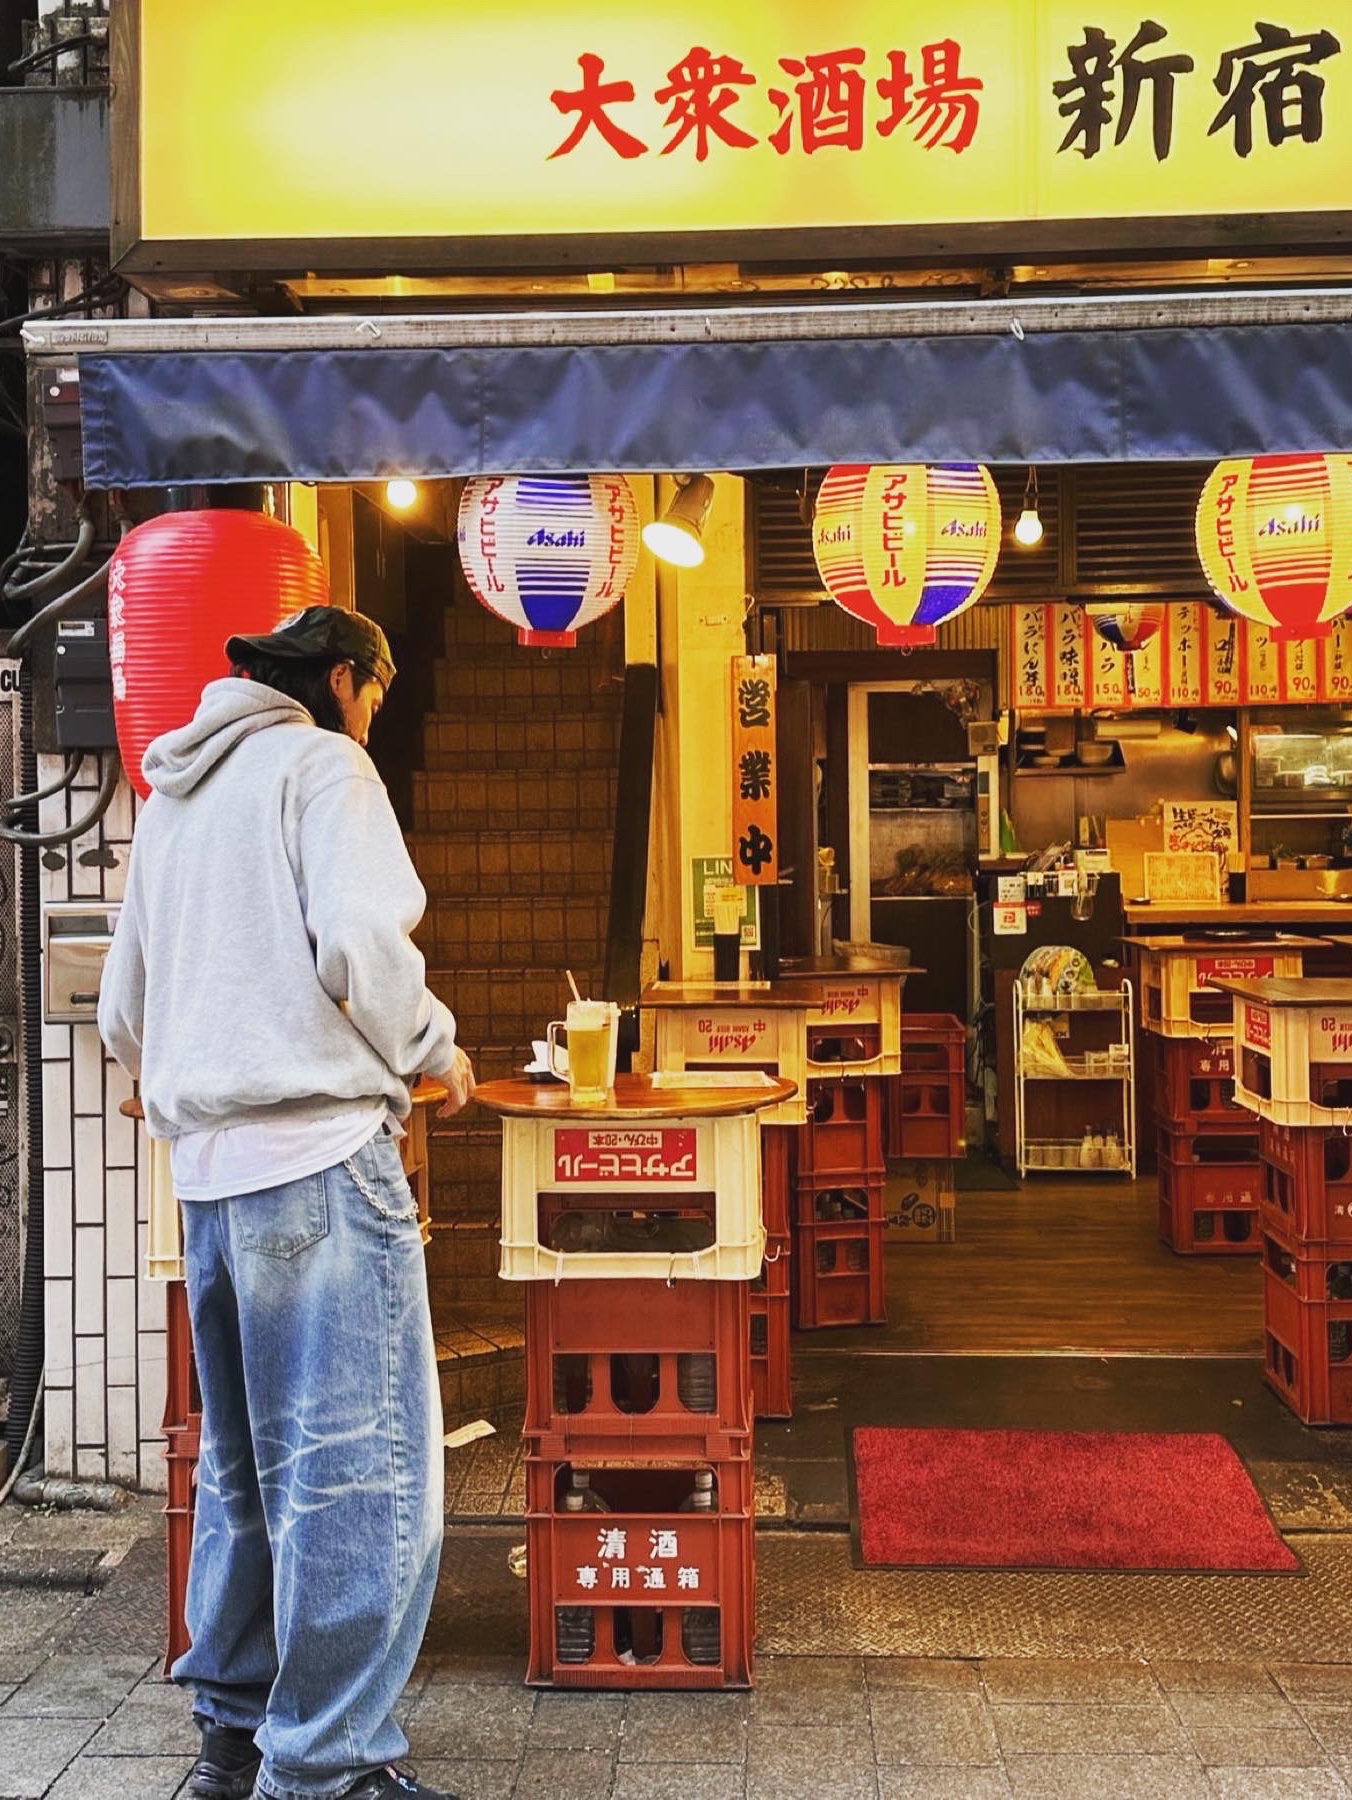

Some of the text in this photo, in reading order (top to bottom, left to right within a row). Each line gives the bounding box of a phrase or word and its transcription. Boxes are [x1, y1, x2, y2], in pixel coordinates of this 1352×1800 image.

[545, 20, 1341, 163] 大衆酒場 新宿
[818, 525, 851, 546] sahi
[882, 474, 908, 587] アサヒビール
[941, 520, 988, 539] Asahi
[1217, 475, 1249, 592] アサヒビール
[1258, 513, 1321, 536] Asahi
[526, 528, 586, 548] Asahi
[595, 484, 625, 598] アサヒビール
[738, 679, 773, 876] 営業中
[698, 1019, 713, 1033] 20
[1321, 1016, 1336, 1031] 20
[708, 1034, 757, 1053] Asahi
[558, 1153, 694, 1177] アサヒビール
[597, 1527, 678, 1559] 清酒
[576, 1565, 700, 1590] 専用通箱
